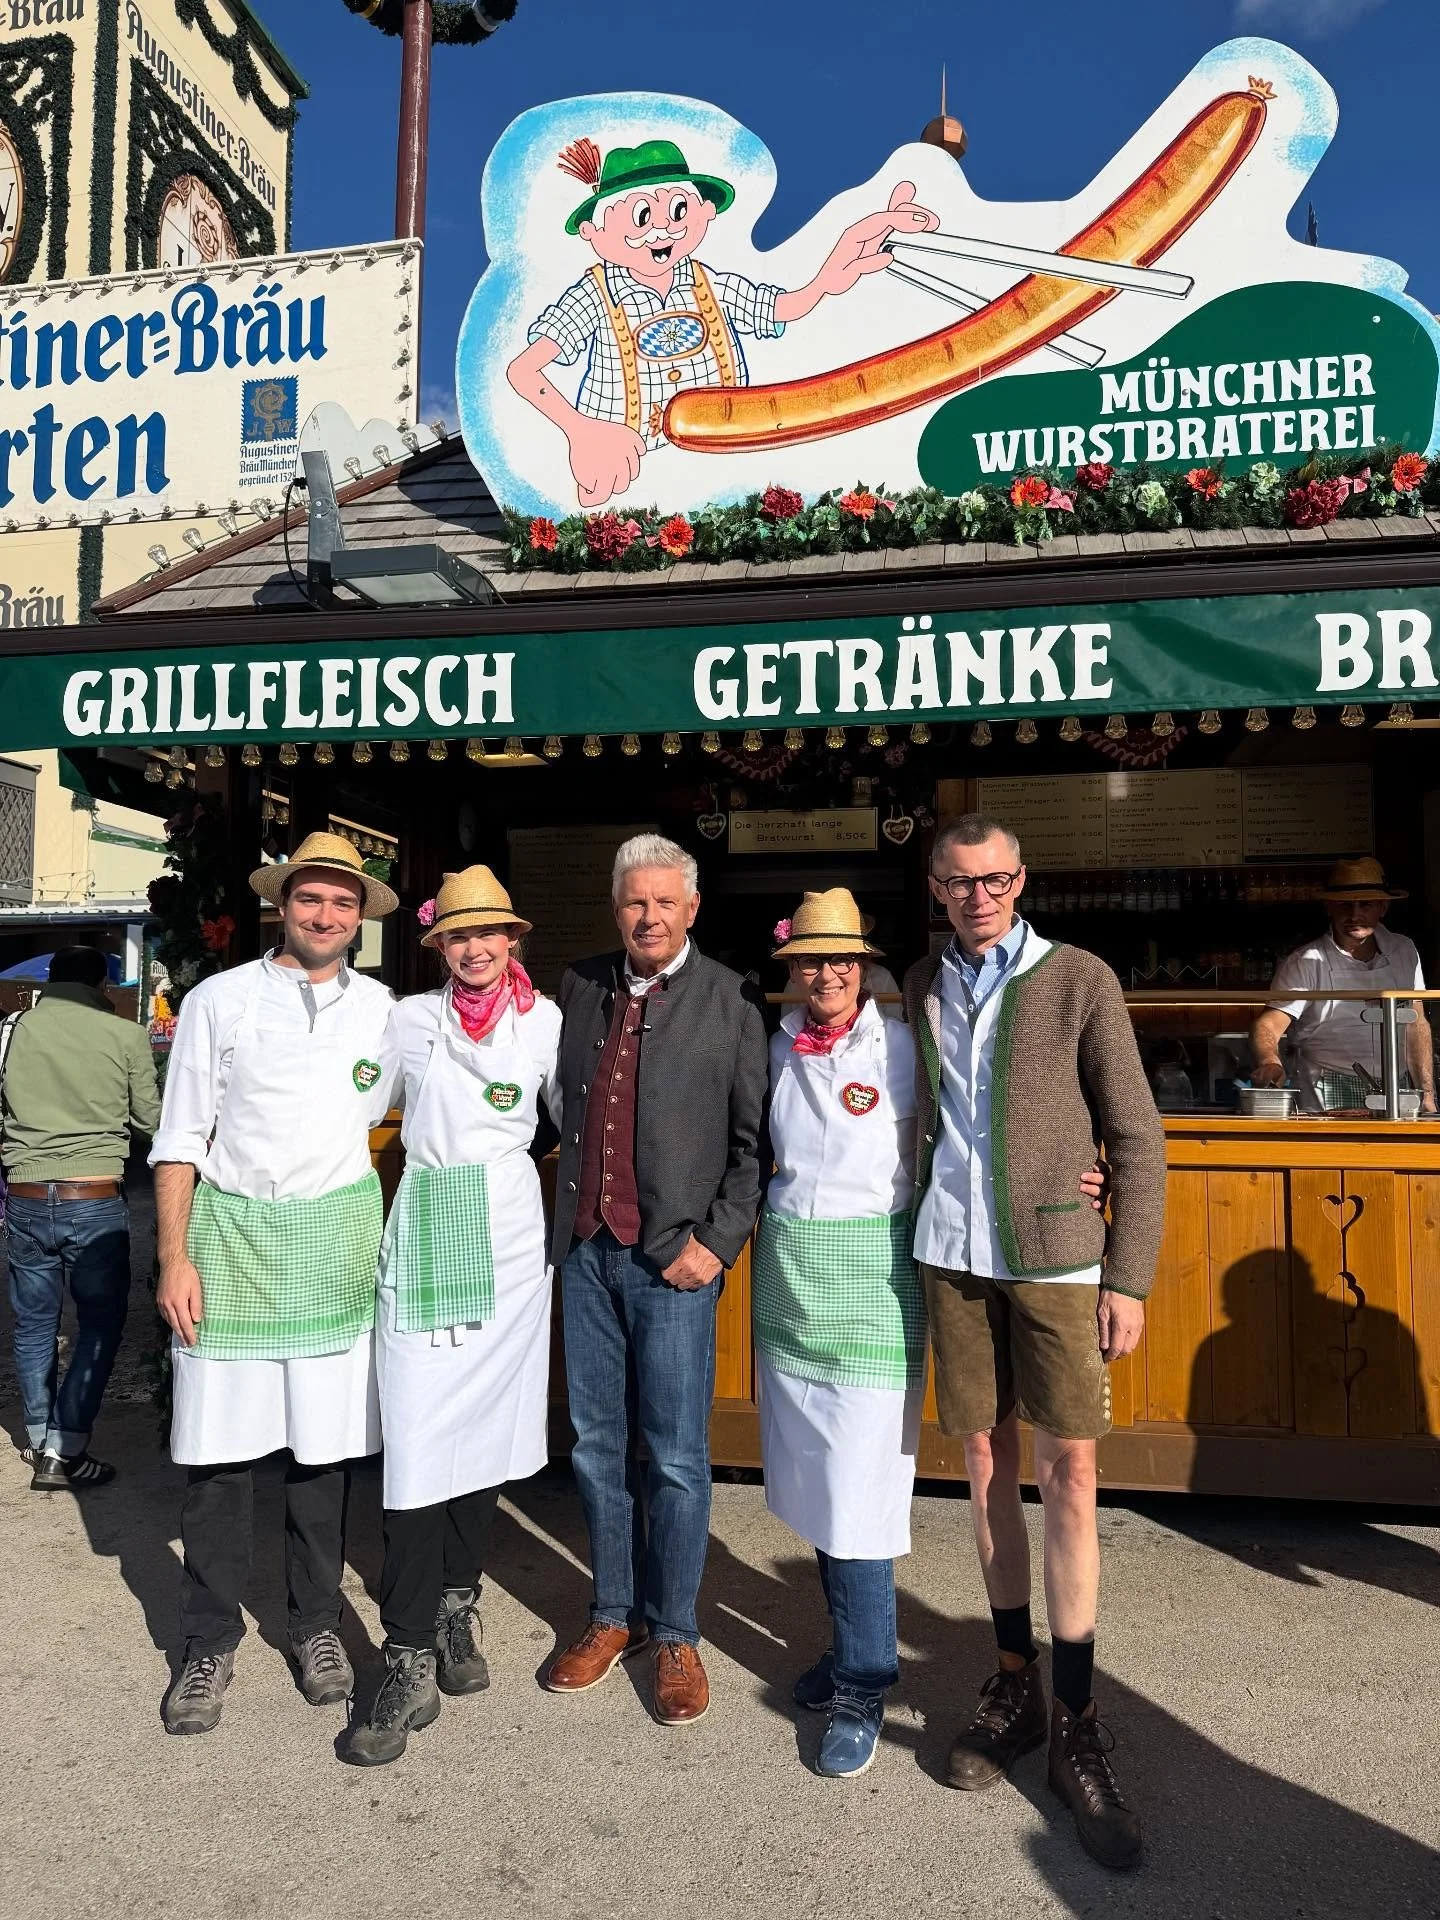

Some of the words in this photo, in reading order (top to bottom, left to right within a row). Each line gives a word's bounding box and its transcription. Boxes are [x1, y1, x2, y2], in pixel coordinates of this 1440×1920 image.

[1098, 353, 1377, 415] MÜNCHNER
[972, 404, 1376, 474] WURSTBRATEREI
[693, 615, 1112, 721] GETRÄNKE
[1314, 609, 1440, 691] BR
[63, 652, 516, 736] GRILLFLEISCH
[734, 820, 752, 830] Die
[756, 819, 807, 830] herzhaft
[811, 818, 843, 831] lange
[756, 833, 816, 843] Bratwurst
